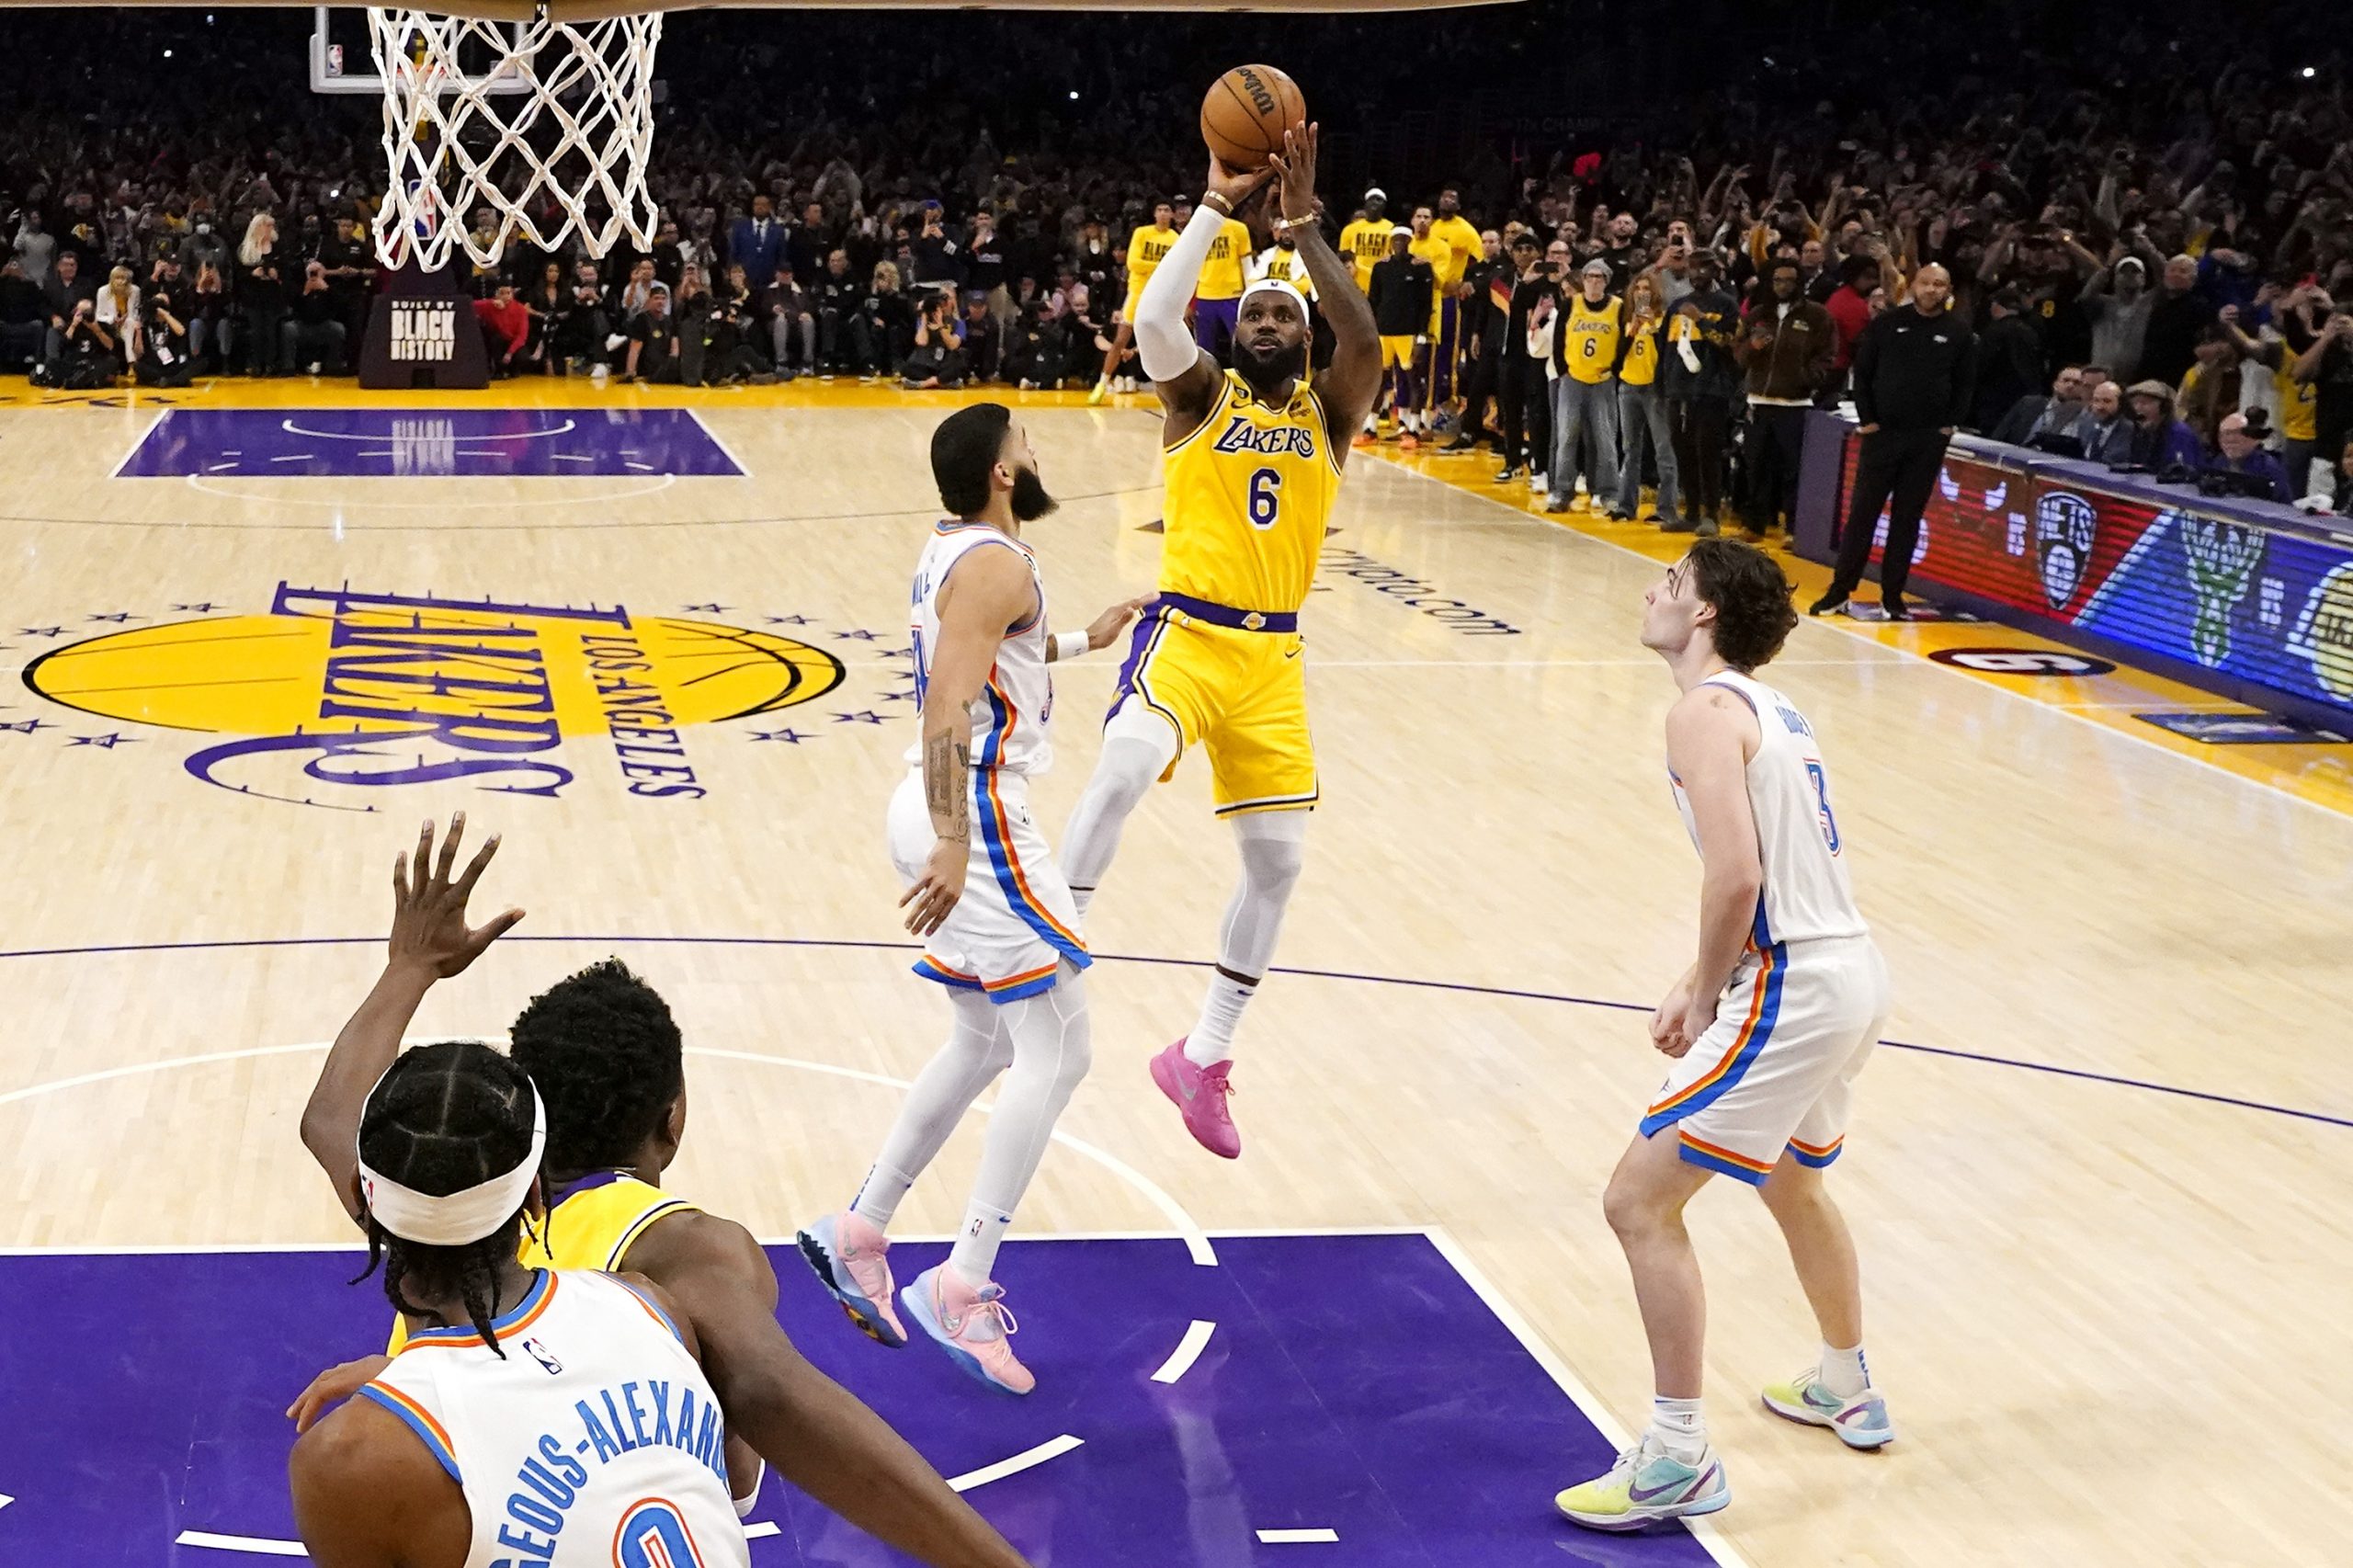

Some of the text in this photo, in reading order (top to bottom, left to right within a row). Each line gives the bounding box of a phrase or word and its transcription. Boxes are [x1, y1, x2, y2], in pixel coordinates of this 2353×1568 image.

[390, 339, 455, 360] HISTORY
[391, 310, 456, 340] BLACK
[1584, 337, 1597, 358] 6
[1635, 340, 1645, 356] 6
[1212, 415, 1314, 459] LAKERS
[1247, 467, 1283, 531] 6
[2038, 497, 2092, 552] NETS
[184, 579, 634, 812] LAKERS
[580, 634, 708, 801] LOS ANGELES
[1802, 756, 1842, 858] 3
